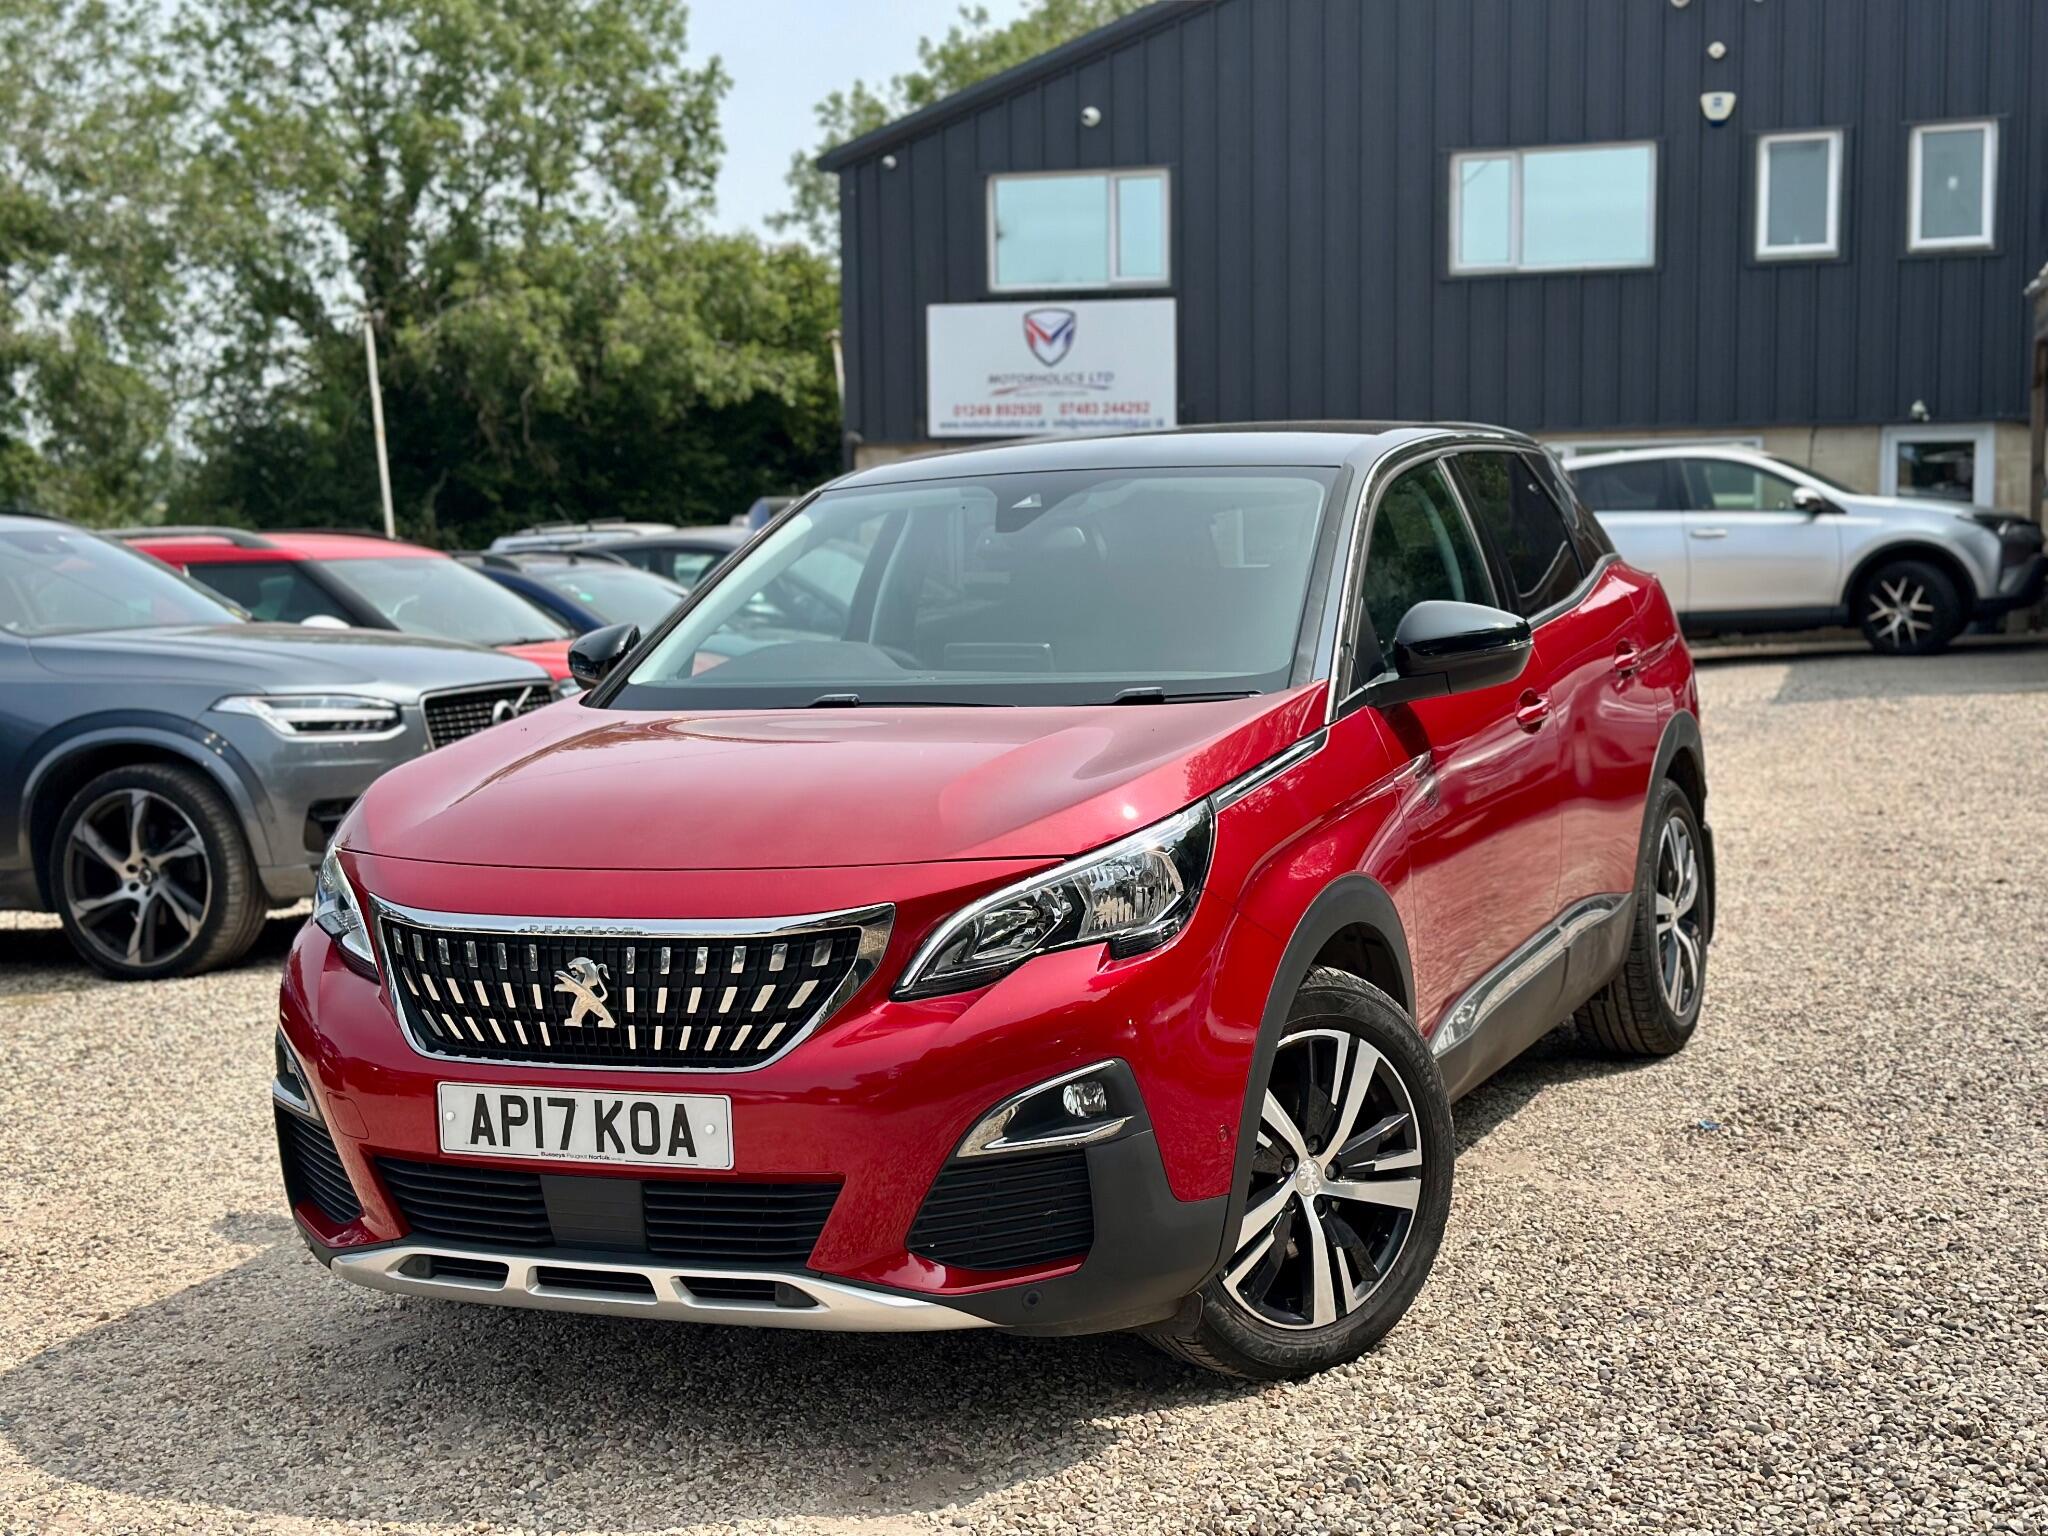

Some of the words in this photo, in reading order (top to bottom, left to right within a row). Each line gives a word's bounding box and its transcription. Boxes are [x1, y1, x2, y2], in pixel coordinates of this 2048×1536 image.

[988, 372, 1084, 384] MOTORHOLICS
[1087, 371, 1115, 384] LTD
[953, 403, 992, 417] 01249
[1059, 401, 1099, 416] 07483
[1103, 400, 1151, 416] 244292
[529, 924, 635, 935] PEUGEOT
[470, 1093, 577, 1151] AP17
[594, 1099, 697, 1158] KOA
